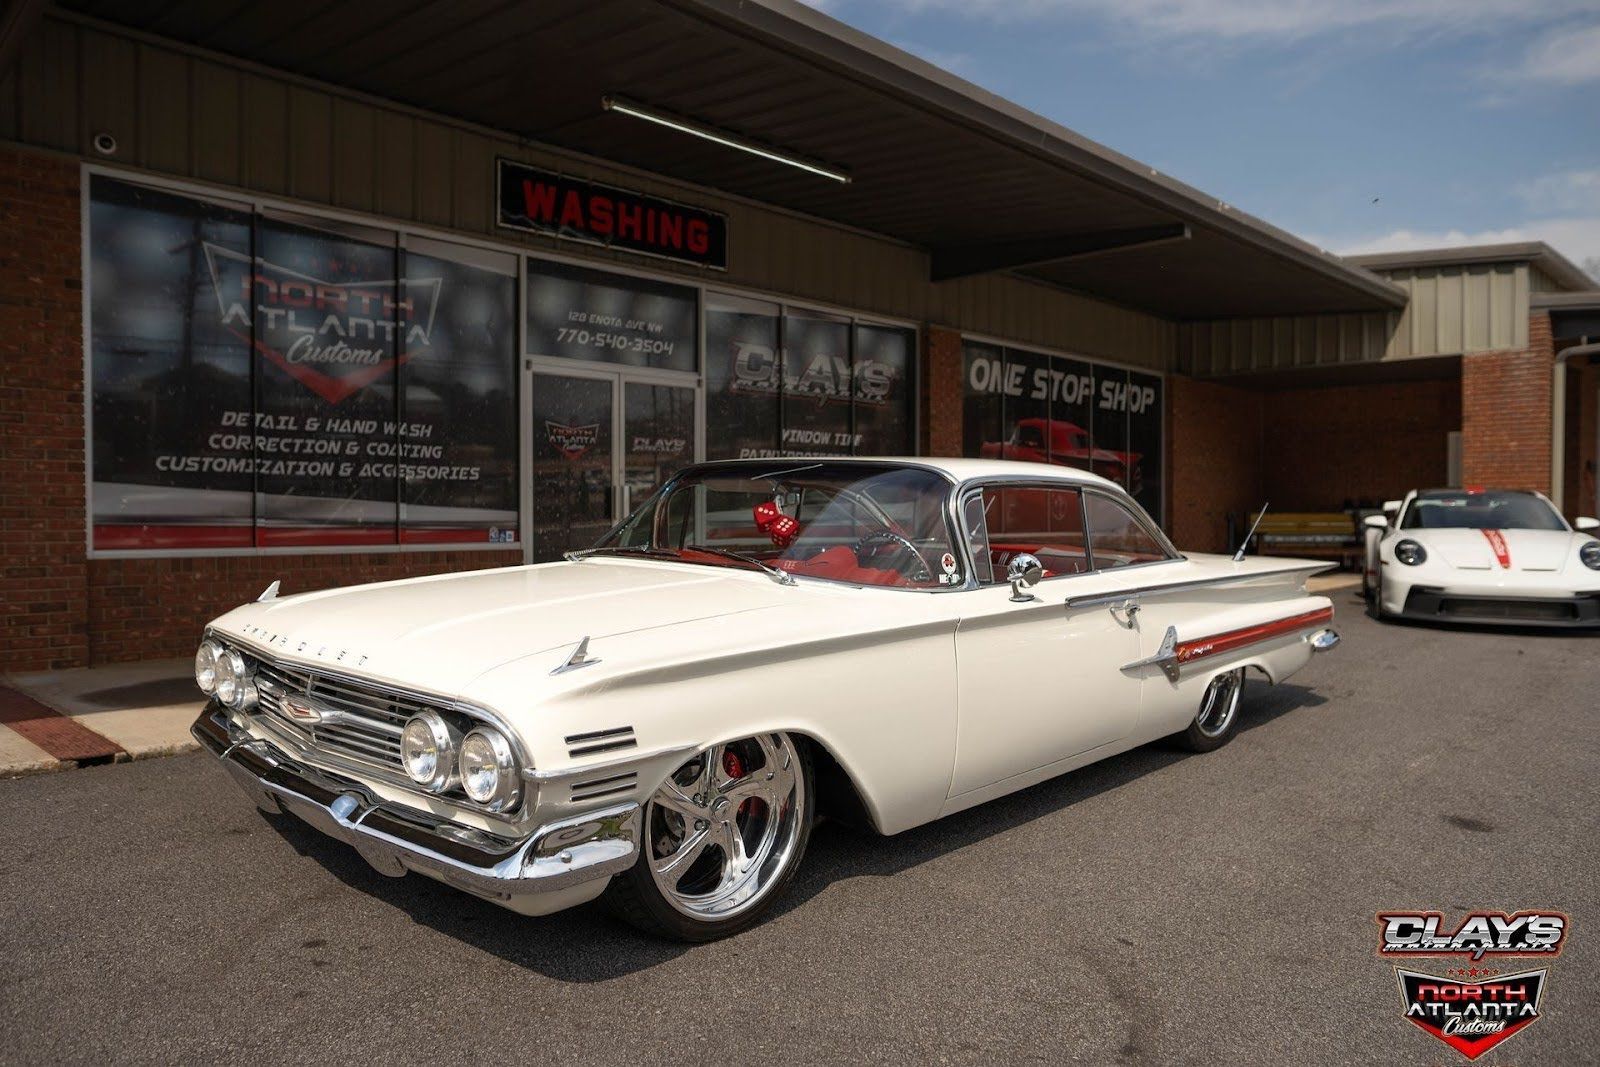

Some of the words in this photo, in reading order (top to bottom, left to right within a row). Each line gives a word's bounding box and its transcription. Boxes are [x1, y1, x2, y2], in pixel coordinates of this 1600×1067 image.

[522, 179, 709, 255] WASHING
[240, 273, 414, 319] NORTH
[222, 303, 430, 345] ATLANTA
[625, 319, 645, 331] AVE
[286, 334, 383, 365] Customs
[970, 358, 1026, 396] ONE
[1030, 368, 1095, 405] STOP
[1099, 380, 1155, 414] SHOP
[221, 411, 298, 430] DETAIL
[305, 417, 321, 432] &
[325, 418, 377, 435] HAND
[383, 421, 433, 438] WASH
[208, 434, 341, 455] CORRECTION
[345, 441, 361, 456] &
[366, 441, 443, 459] COATING
[155, 455, 335, 477] CUSTOMIZATION
[338, 462, 354, 477] &
[358, 463, 481, 481] ACCESSORIES
